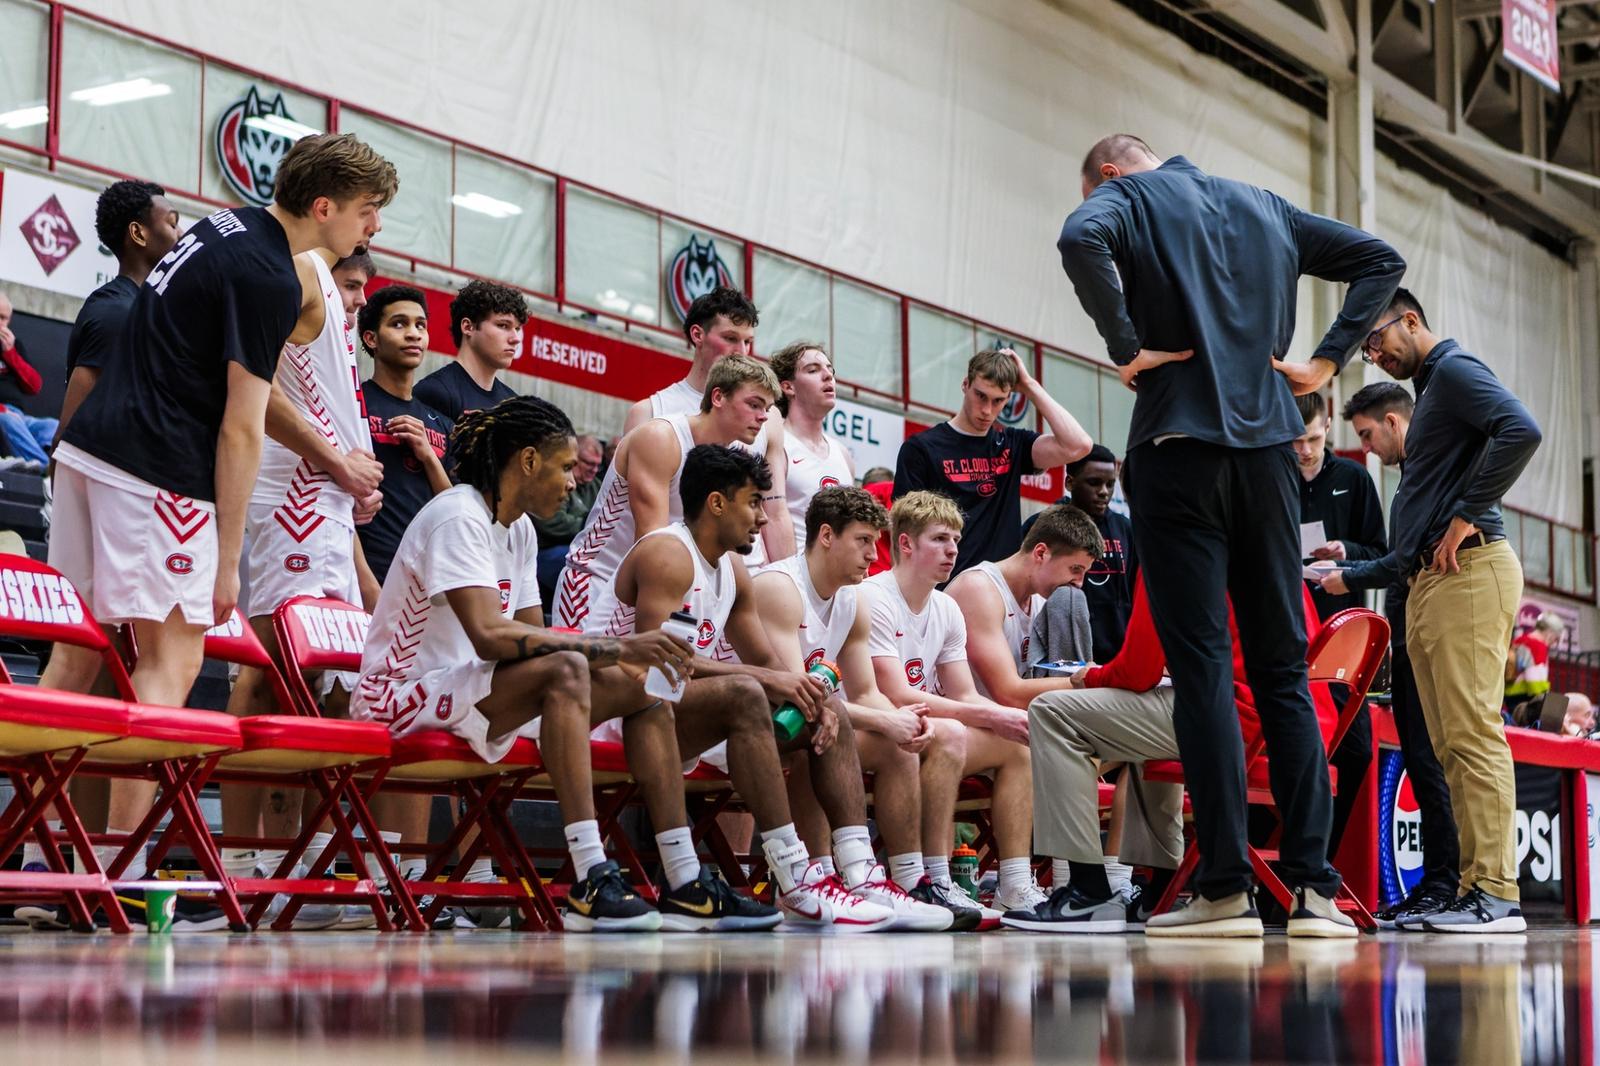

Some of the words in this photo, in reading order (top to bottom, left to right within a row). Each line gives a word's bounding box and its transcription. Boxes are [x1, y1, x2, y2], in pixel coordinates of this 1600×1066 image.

[146, 233, 204, 296] 21
[532, 335, 607, 375] RESERVED
[960, 457, 990, 473] CLOUD
